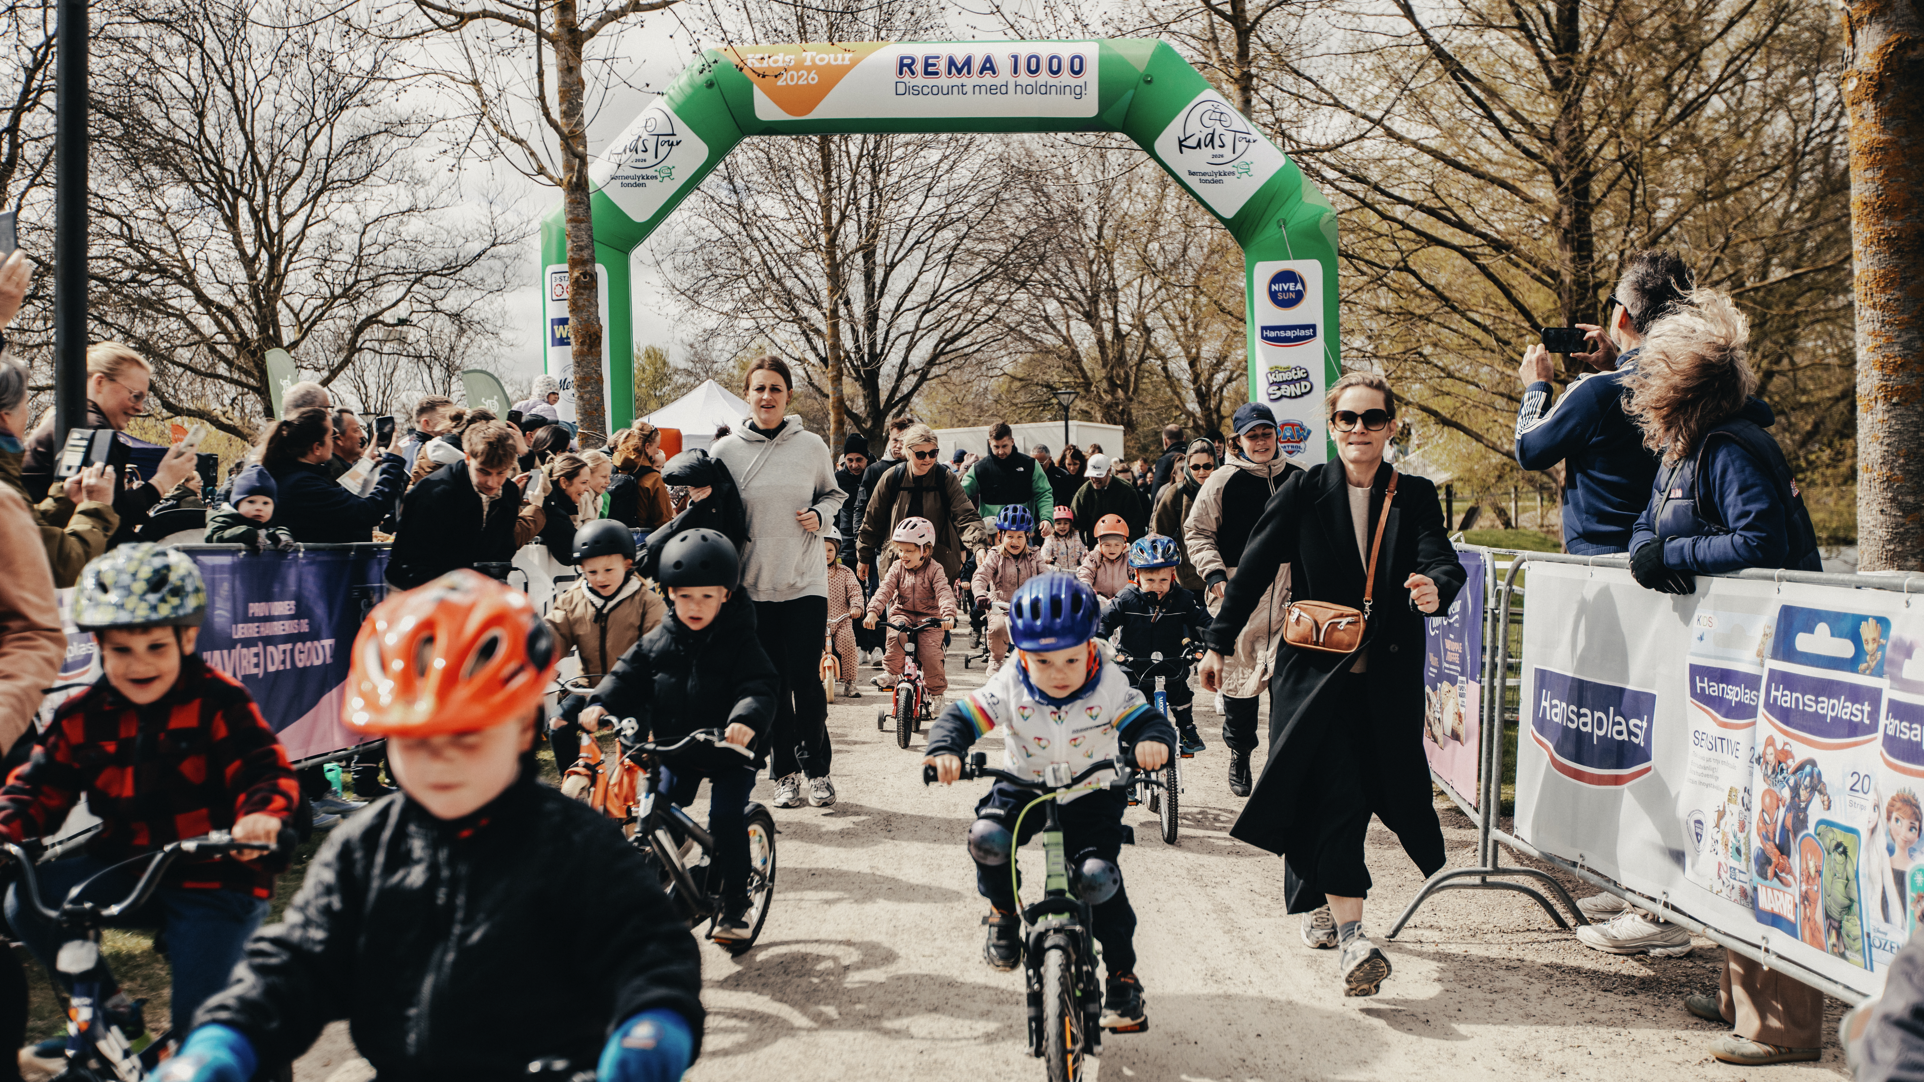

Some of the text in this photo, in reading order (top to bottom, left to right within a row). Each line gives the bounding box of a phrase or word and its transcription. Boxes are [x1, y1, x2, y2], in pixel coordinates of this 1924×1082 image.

[746, 52, 853, 67] Kids Tour
[896, 53, 1087, 79] REMA 1000
[777, 70, 818, 86] 2026
[895, 81, 1087, 100] Discount med holdning!
[648, 133, 682, 159] Tour
[1178, 128, 1257, 154] Kids Tour
[1271, 282, 1303, 292] NIVEA
[1277, 292, 1296, 300] SUN
[1262, 327, 1314, 339] Hansaplast
[267, 643, 293, 672] DET
[1770, 683, 1871, 724] Hansaplast
[1539, 689, 1647, 747] Hansaplast
[1693, 730, 1741, 759] SENSITIVE
[1849, 771, 1871, 795] 20
[1848, 800, 1867, 812] Strips
[1757, 884, 1795, 921] MARVEL
